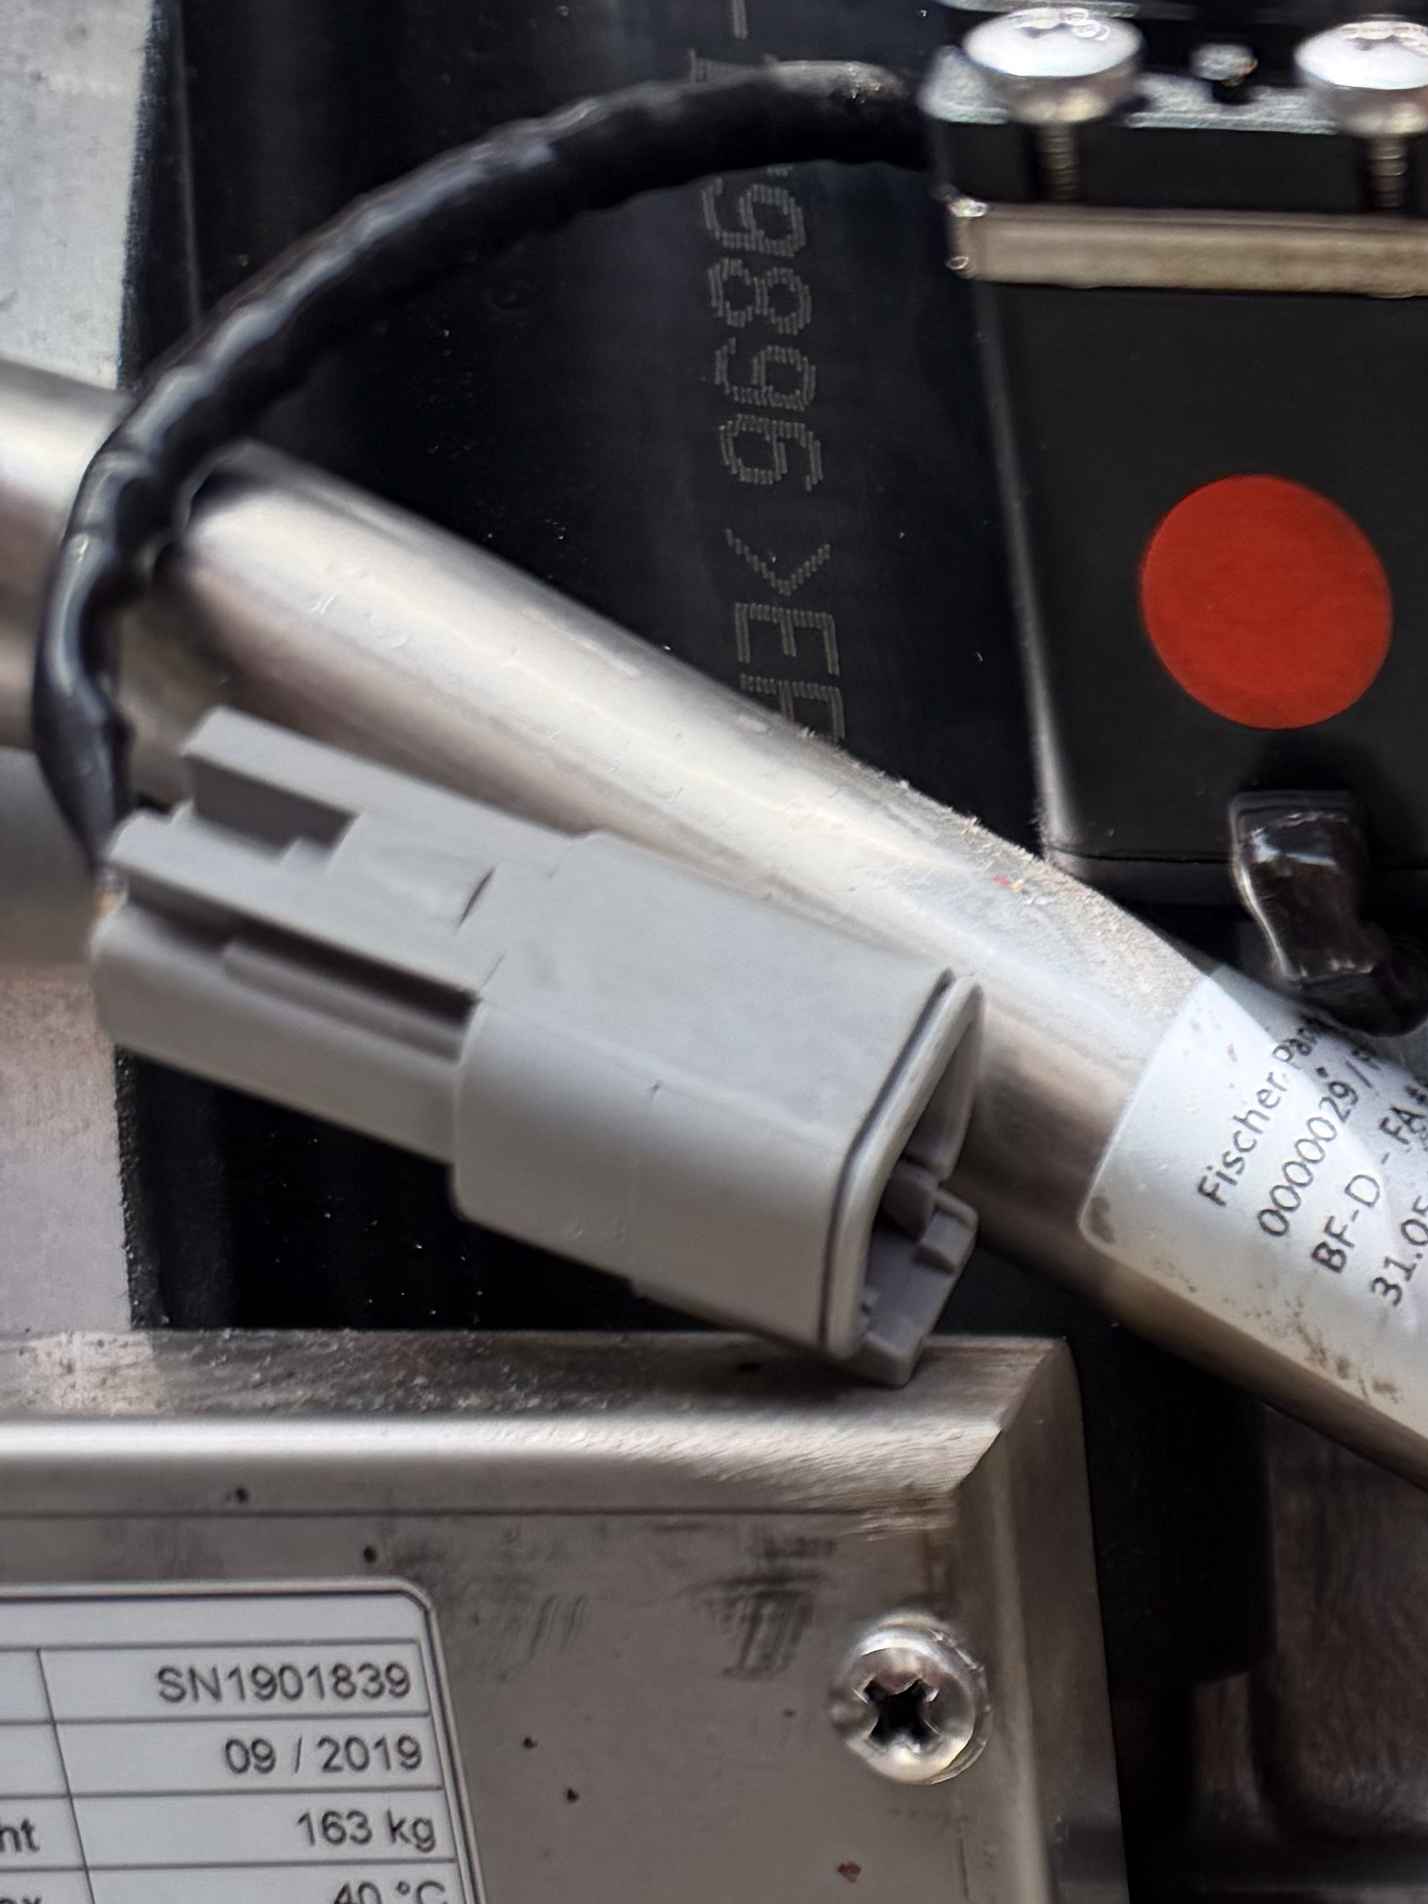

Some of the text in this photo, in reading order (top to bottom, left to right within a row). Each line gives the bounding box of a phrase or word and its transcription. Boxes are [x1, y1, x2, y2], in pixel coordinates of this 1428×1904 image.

[700, 165, 823, 492] 9896
[1197, 1071, 1288, 1207] Fischer
[157, 1662, 412, 1704] SN1901839
[225, 1735, 423, 1774] 09 2019
[298, 1808, 437, 1853] 163 kg
